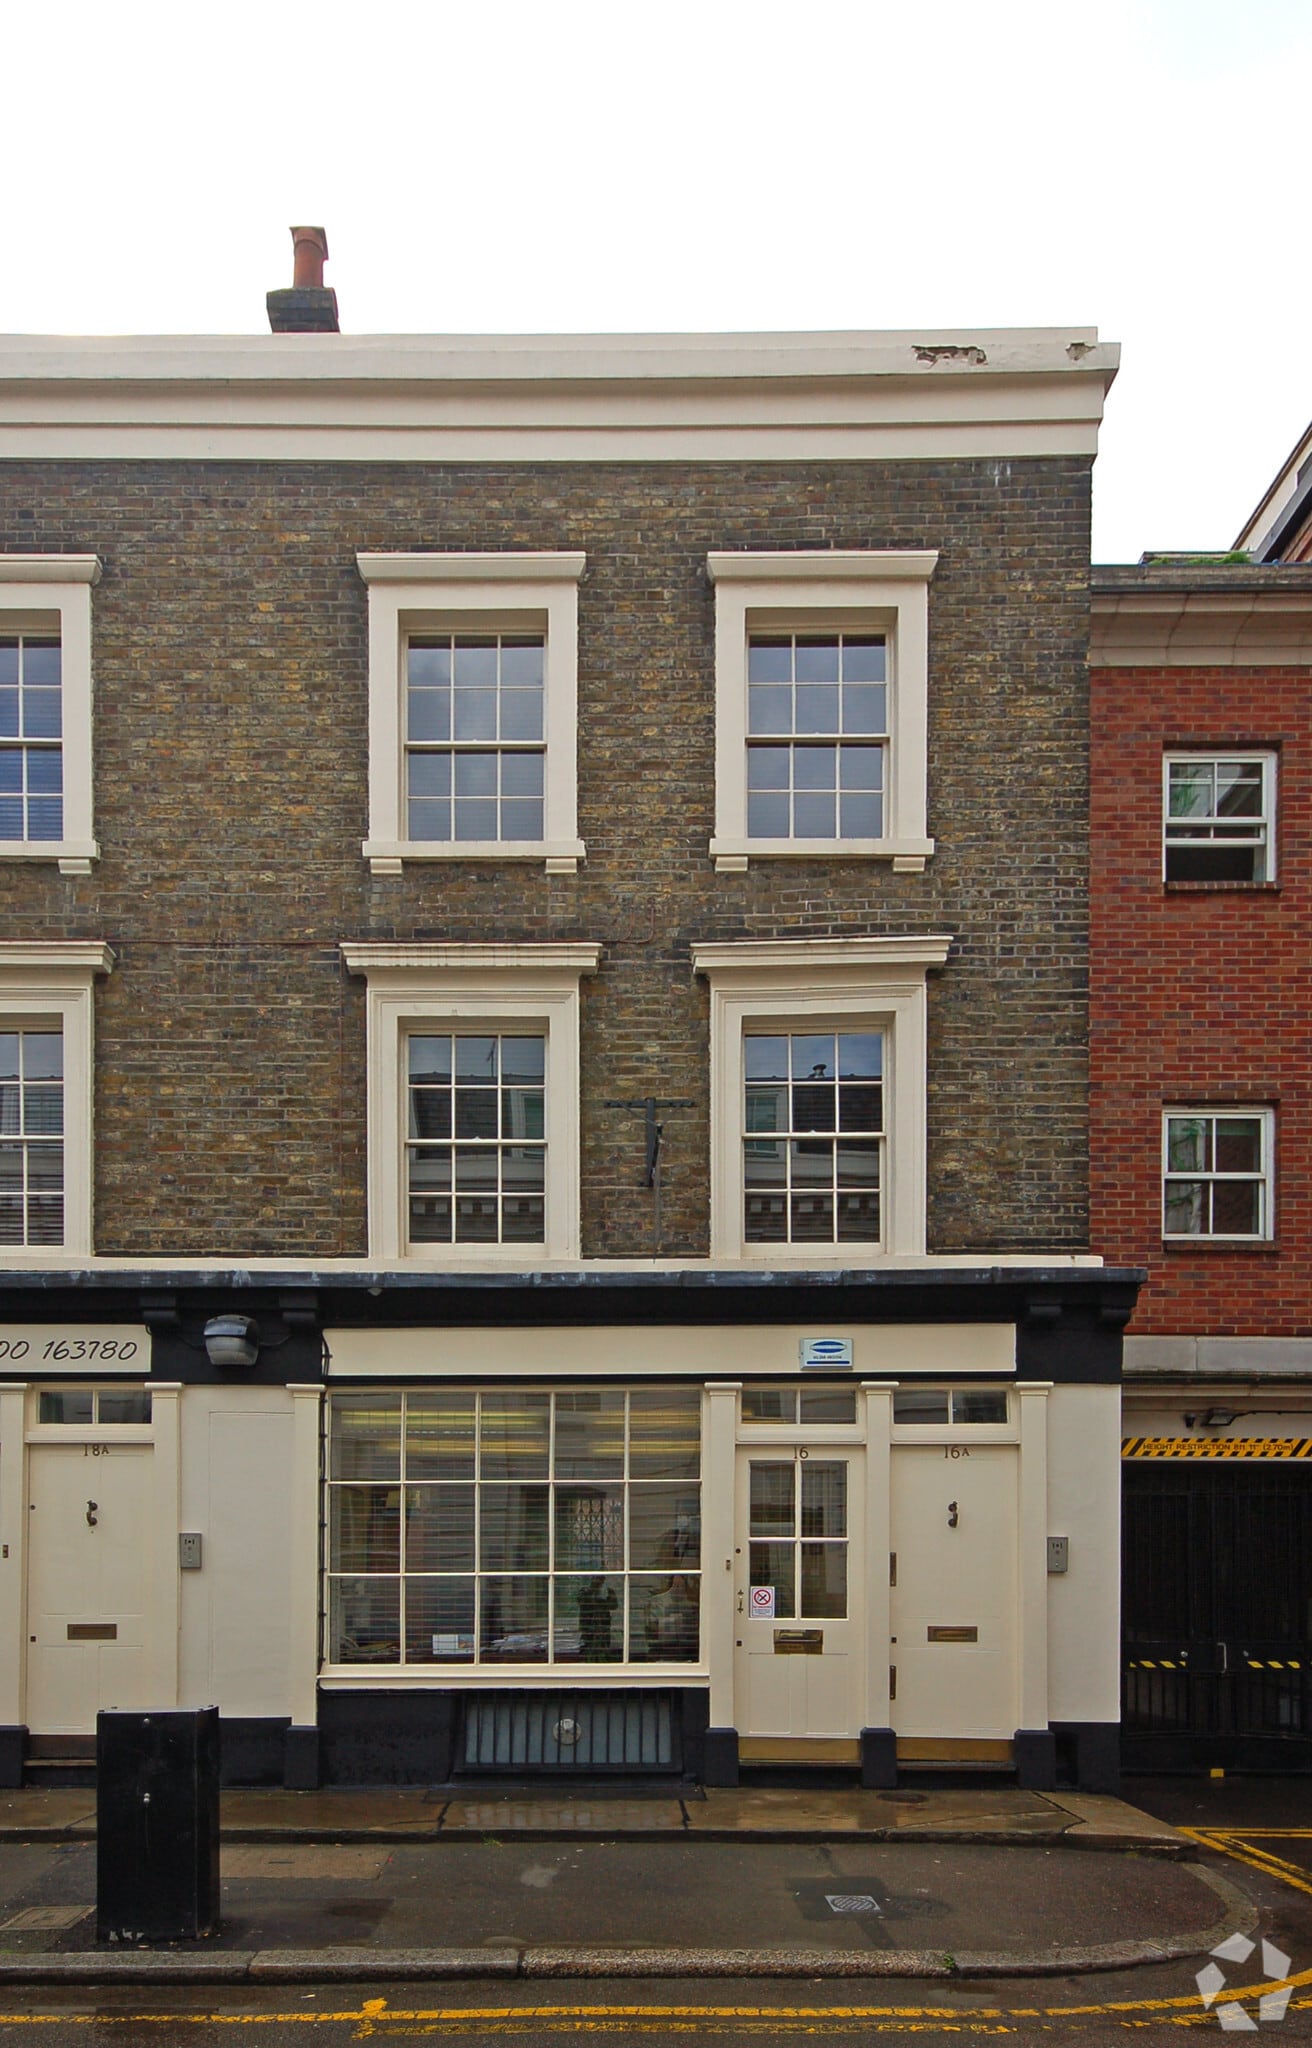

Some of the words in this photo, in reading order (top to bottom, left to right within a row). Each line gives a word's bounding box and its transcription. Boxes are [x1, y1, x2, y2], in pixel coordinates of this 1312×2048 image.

[42, 1340, 138, 1361] 163780
[84, 1443, 110, 1457] 18A
[793, 1446, 809, 1459] 16
[944, 1444, 970, 1459] 16A
